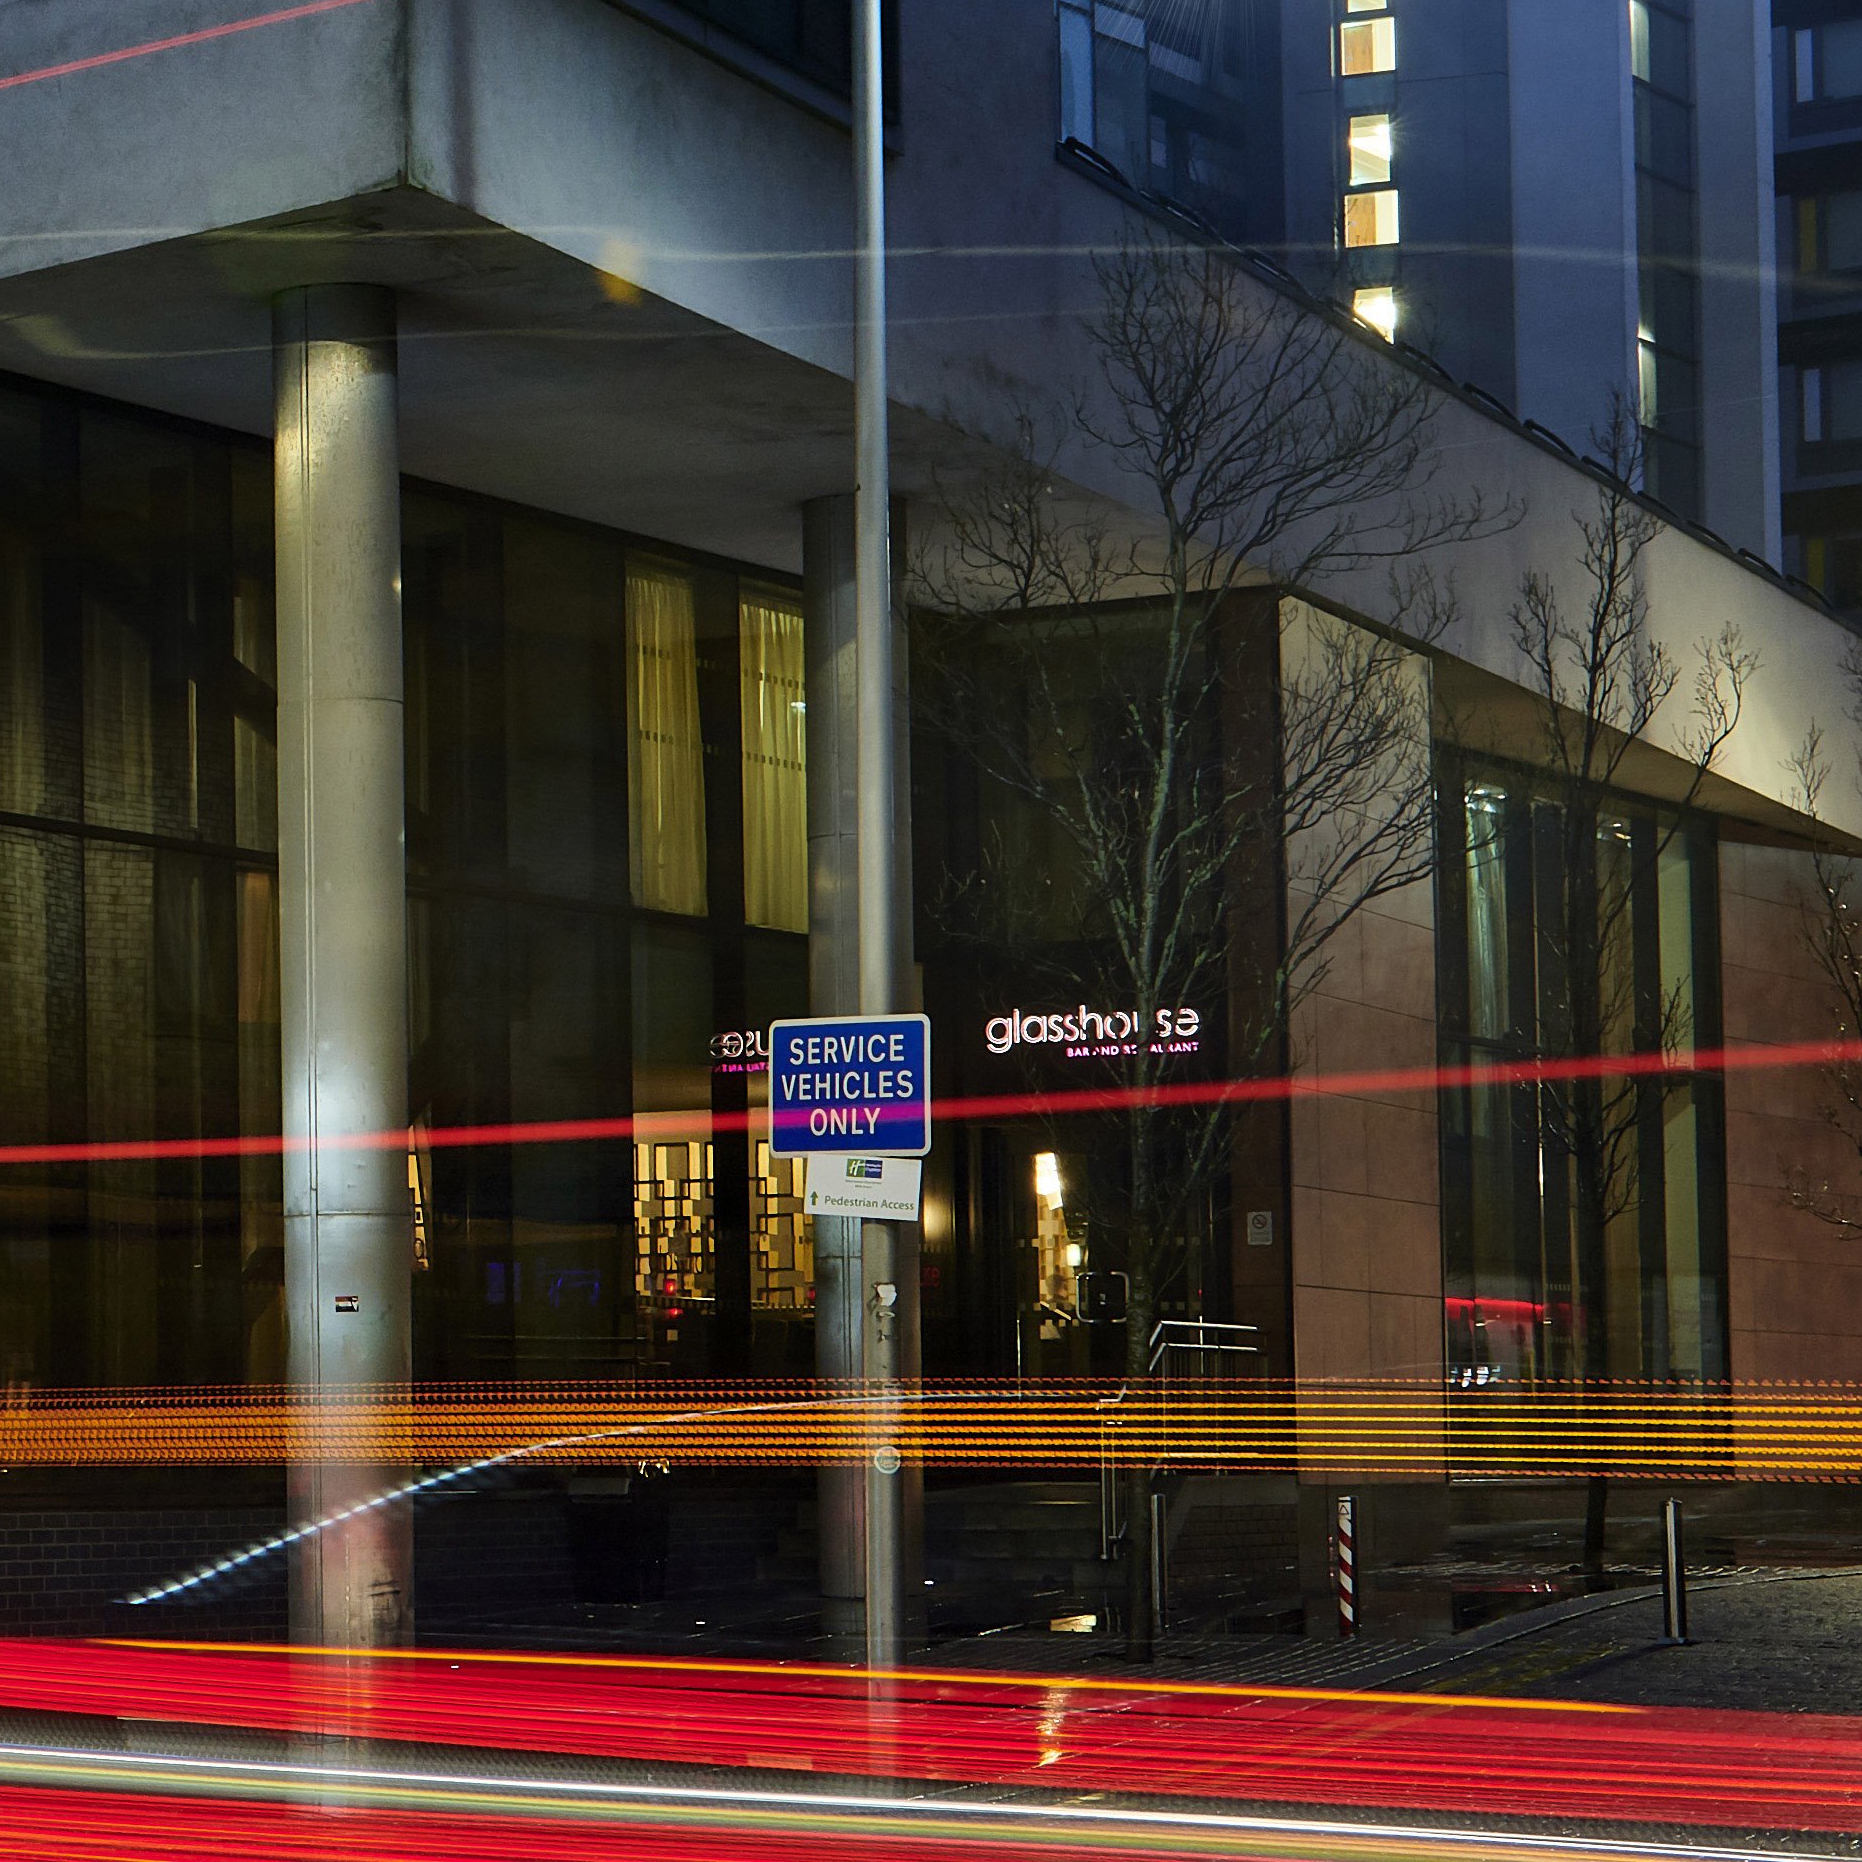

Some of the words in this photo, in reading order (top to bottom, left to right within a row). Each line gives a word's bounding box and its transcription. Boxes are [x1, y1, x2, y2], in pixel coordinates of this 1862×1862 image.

[789, 1034, 905, 1065] SERVICE
[1066, 1046, 1090, 1057] BAR
[781, 1070, 914, 1101] VEHICLES
[809, 1107, 881, 1136] ONLY
[824, 1195, 878, 1208] Pedestrian
[880, 1199, 915, 1210] Access
